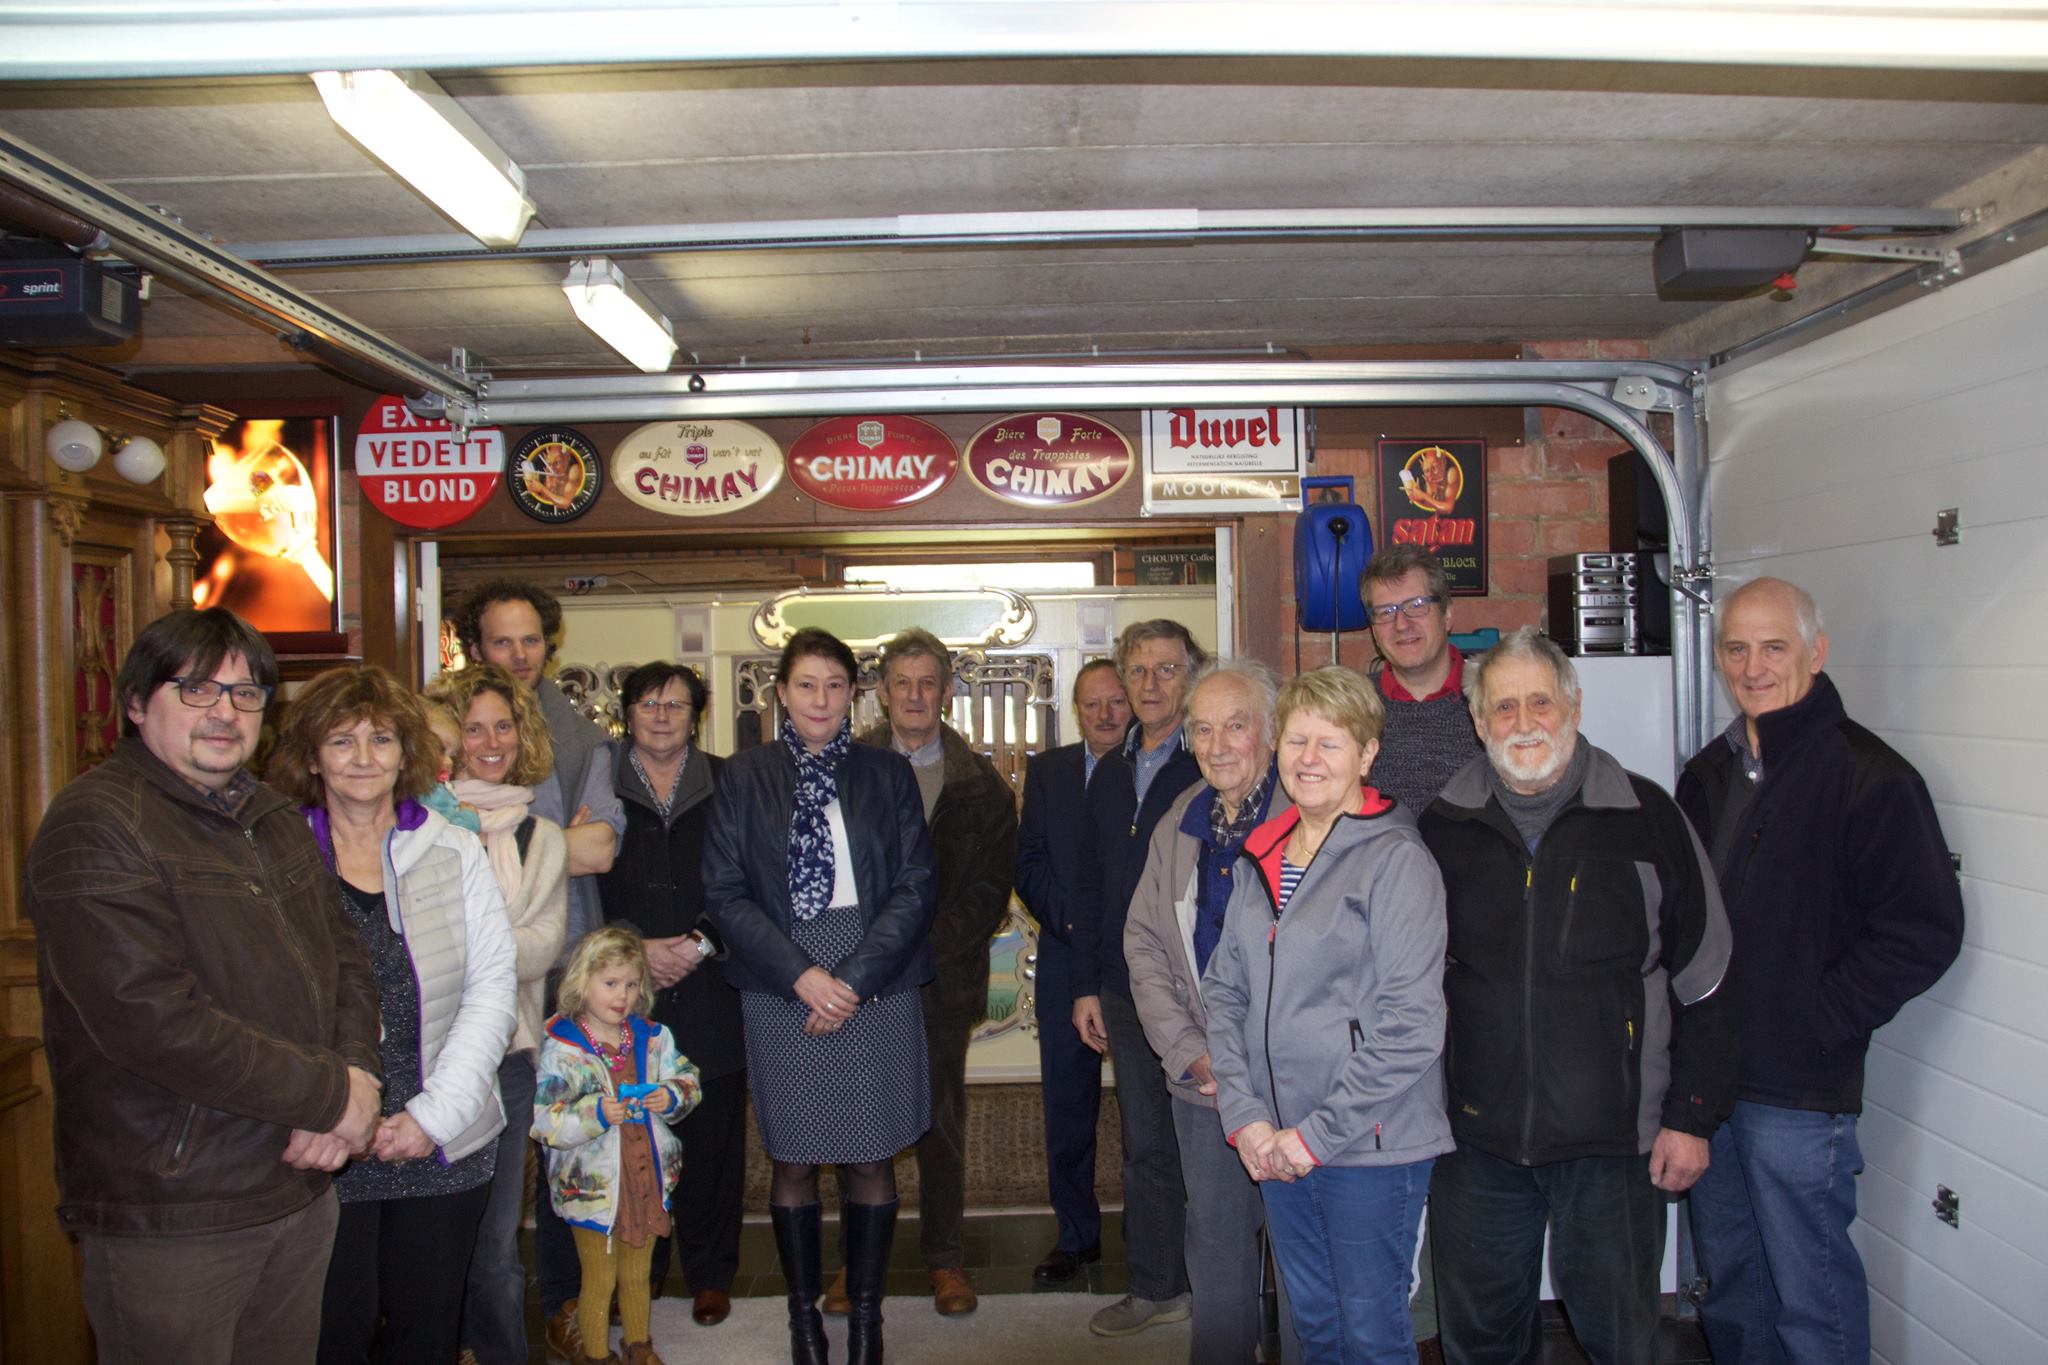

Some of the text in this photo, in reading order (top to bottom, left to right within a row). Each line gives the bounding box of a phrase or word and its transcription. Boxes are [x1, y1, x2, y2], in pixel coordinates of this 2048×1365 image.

[23, 282, 61, 296] sprint
[677, 424, 714, 441] Triple
[1070, 428, 1102, 443] Forte
[1167, 406, 1281, 449] Duvel
[368, 438, 493, 468] VEDETT
[1008, 449, 1090, 462] des Trappistes
[808, 454, 936, 481] CHIMAY
[985, 456, 1112, 496] CHIMAY
[383, 478, 476, 504] BLOND
[634, 462, 758, 504] CHIMAY
[1392, 512, 1475, 554] satan
[1141, 554, 1188, 564] CHOUFFE
[1442, 557, 1477, 569] BLOCK
